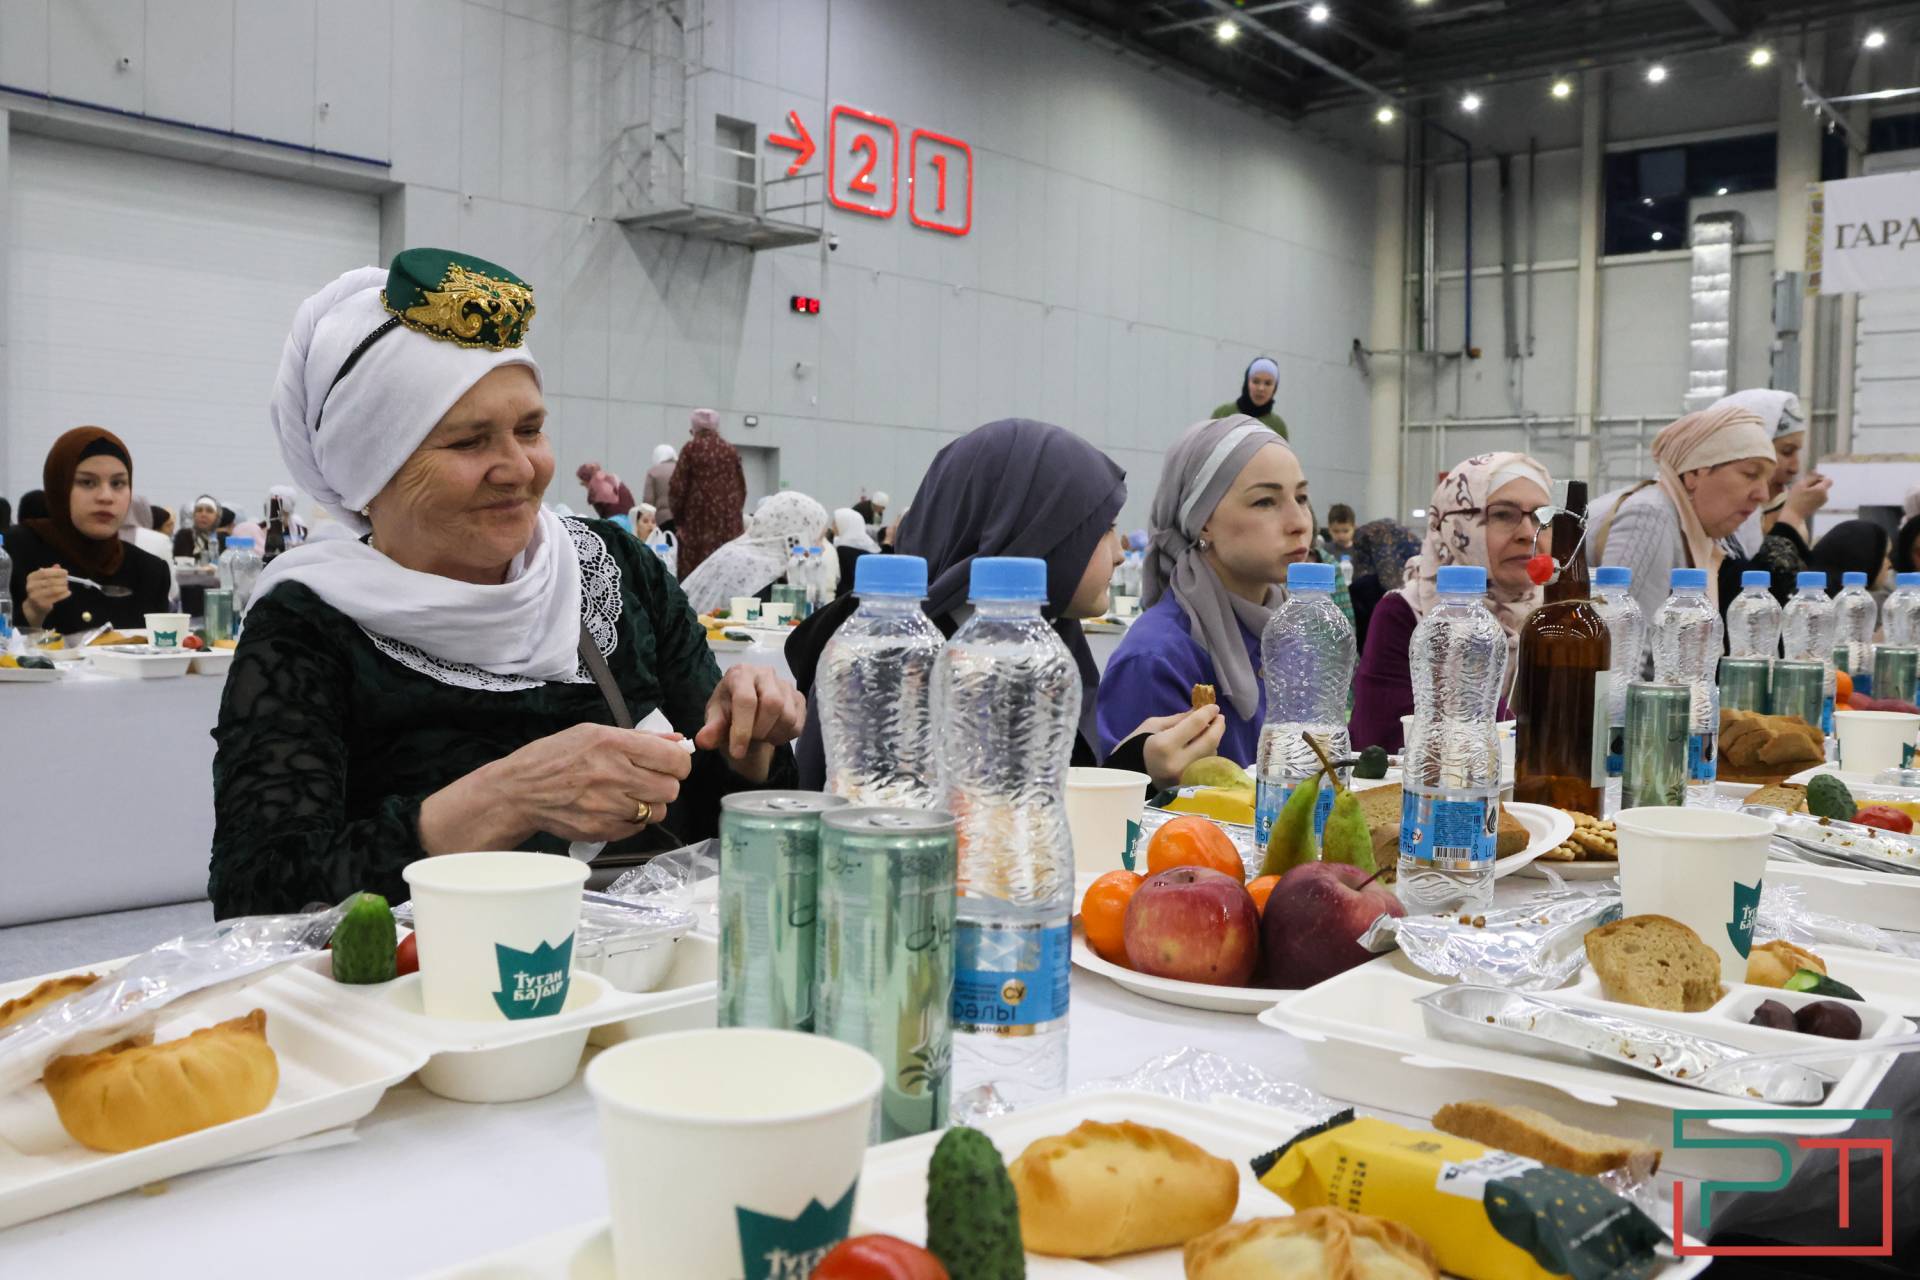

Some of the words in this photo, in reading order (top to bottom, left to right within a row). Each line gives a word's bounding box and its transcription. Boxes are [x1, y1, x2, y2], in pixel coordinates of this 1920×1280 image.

[850, 134, 877, 194] 2
[931, 154, 947, 212] 1
[513, 970, 563, 989] Туган
